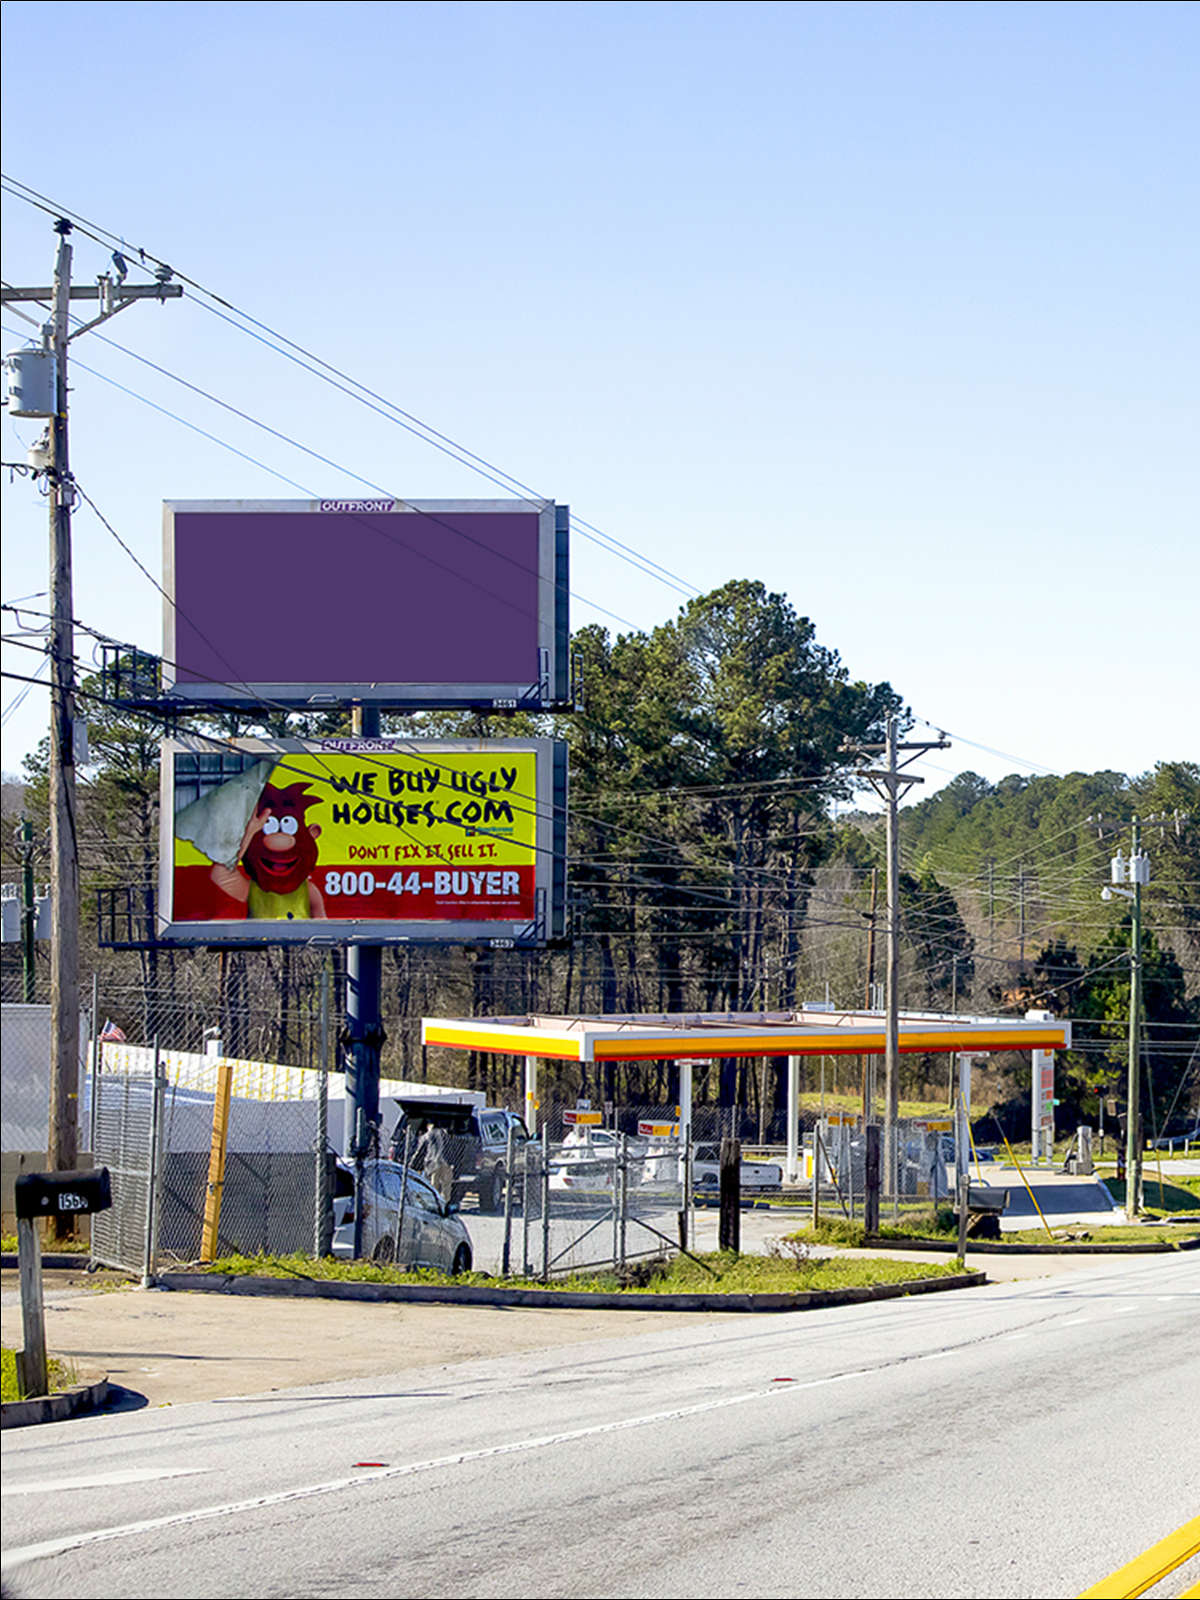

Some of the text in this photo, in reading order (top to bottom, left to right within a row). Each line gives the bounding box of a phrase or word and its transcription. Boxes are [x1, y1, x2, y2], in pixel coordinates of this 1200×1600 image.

[321, 501, 391, 512] OUTFRONT
[322, 740, 392, 751] OUTFRONT
[329, 766, 517, 797] WE BUY UGLY
[348, 844, 391, 860] DON'T
[394, 844, 422, 862] FIX
[447, 843, 475, 861] SELL
[477, 843, 498, 858] IT.
[324, 871, 521, 897] 800-44-BUYER
